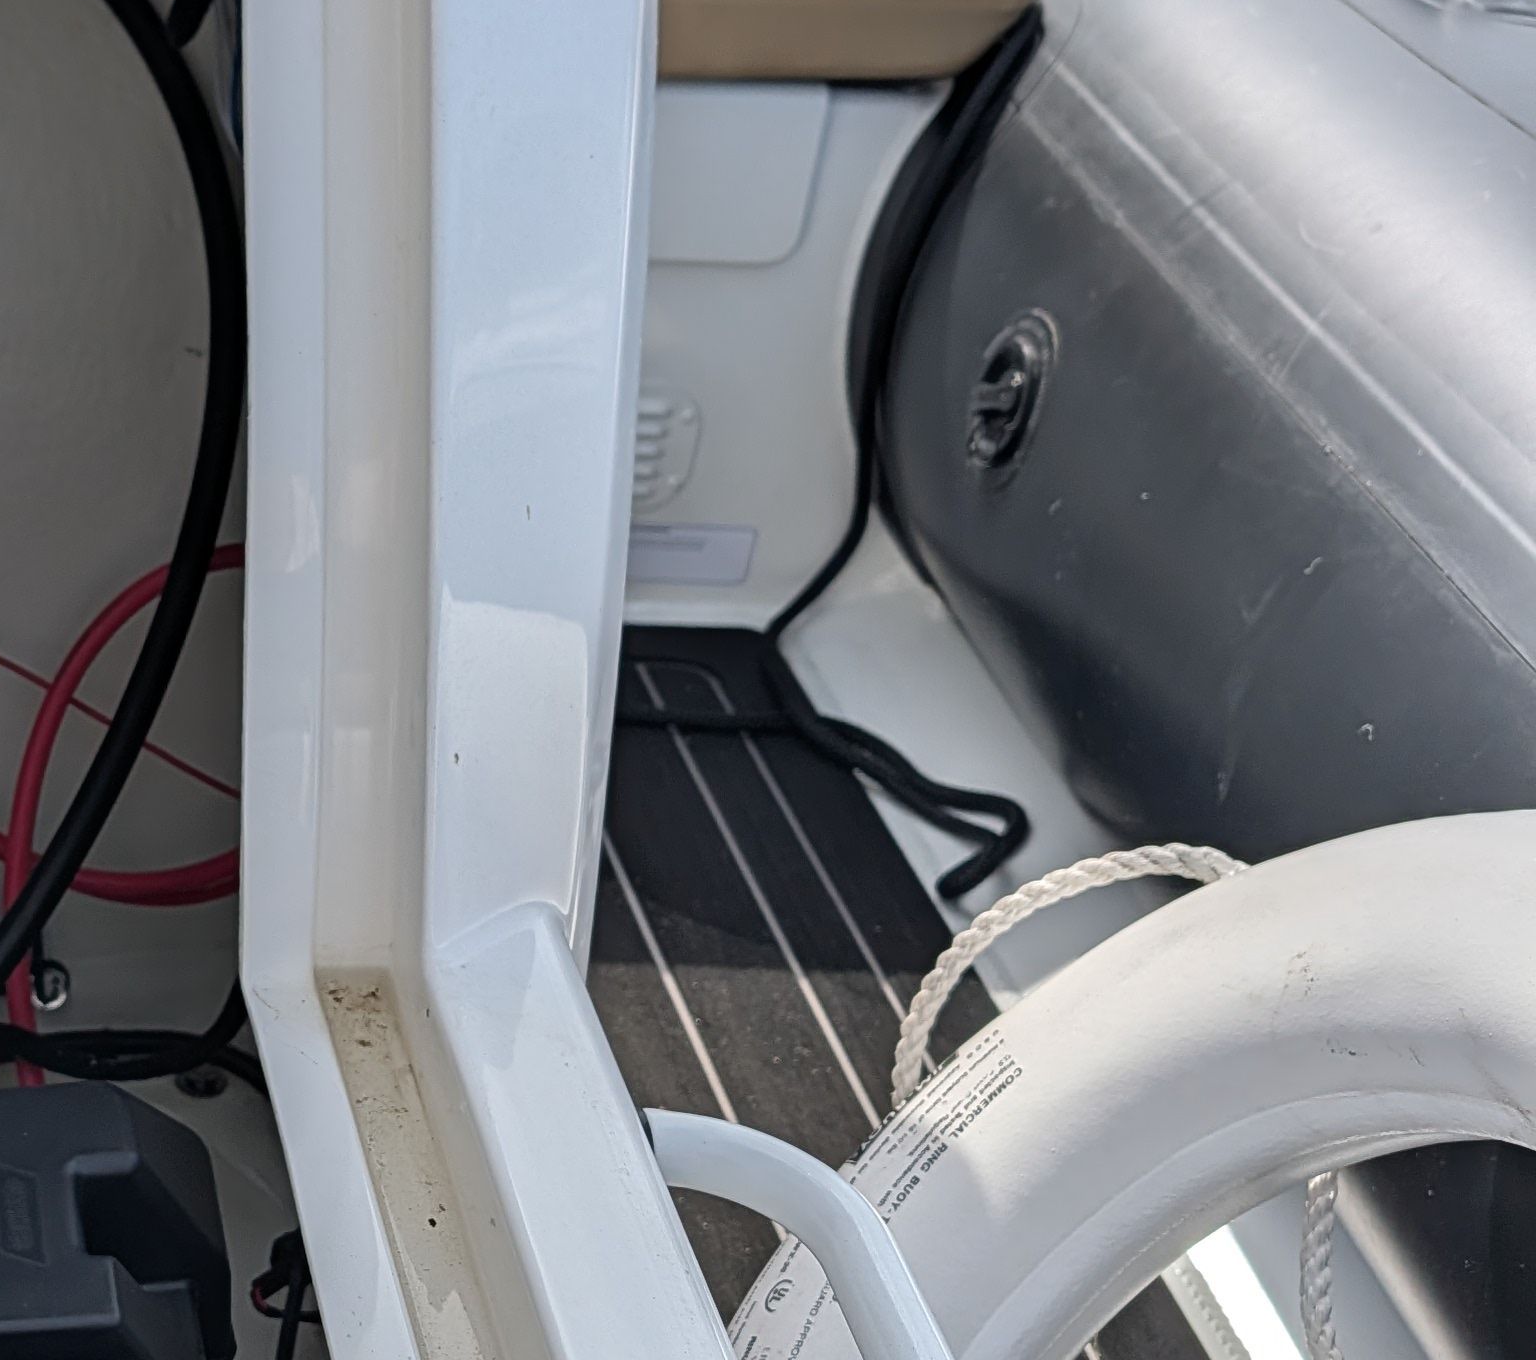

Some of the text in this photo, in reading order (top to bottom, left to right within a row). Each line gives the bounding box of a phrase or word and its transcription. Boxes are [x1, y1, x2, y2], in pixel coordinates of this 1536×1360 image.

[948, 1067, 1024, 1139] COMMERCIAL
[920, 1142, 949, 1173] RING
[809, 1280, 830, 1317] UARD
